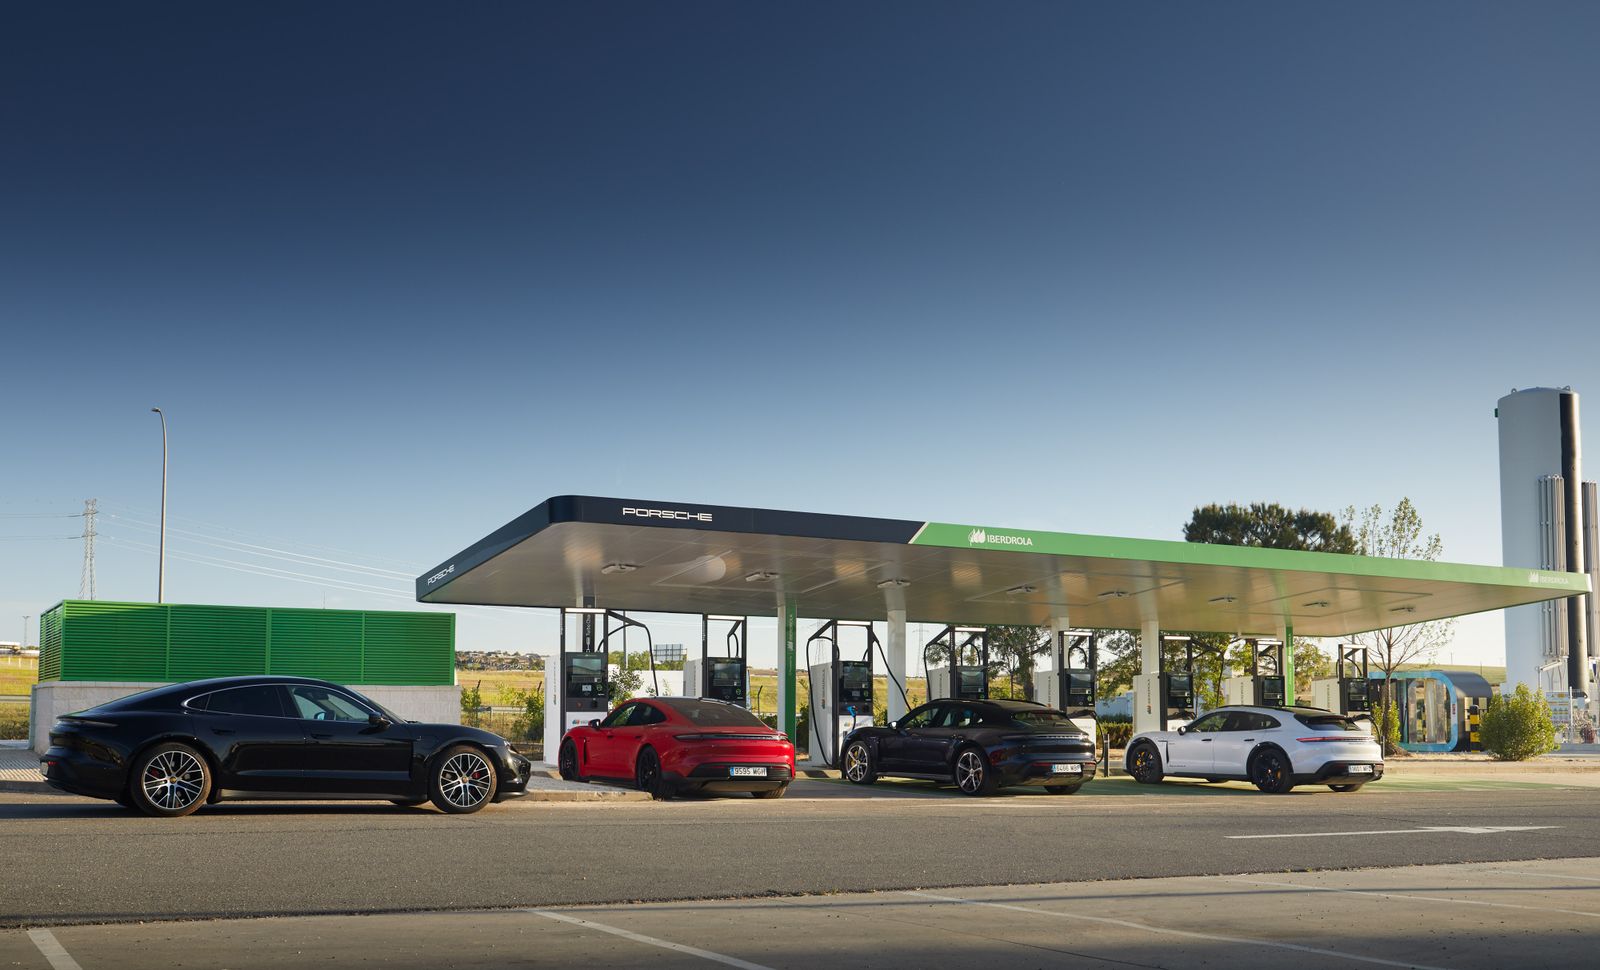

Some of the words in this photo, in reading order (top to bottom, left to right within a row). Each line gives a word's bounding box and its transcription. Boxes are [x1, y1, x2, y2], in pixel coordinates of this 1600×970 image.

[622, 507, 712, 522] PORSCHE
[987, 534, 1033, 546] IBERDROLA
[427, 564, 455, 586] PORSCHE
[735, 767, 751, 775] 9595
